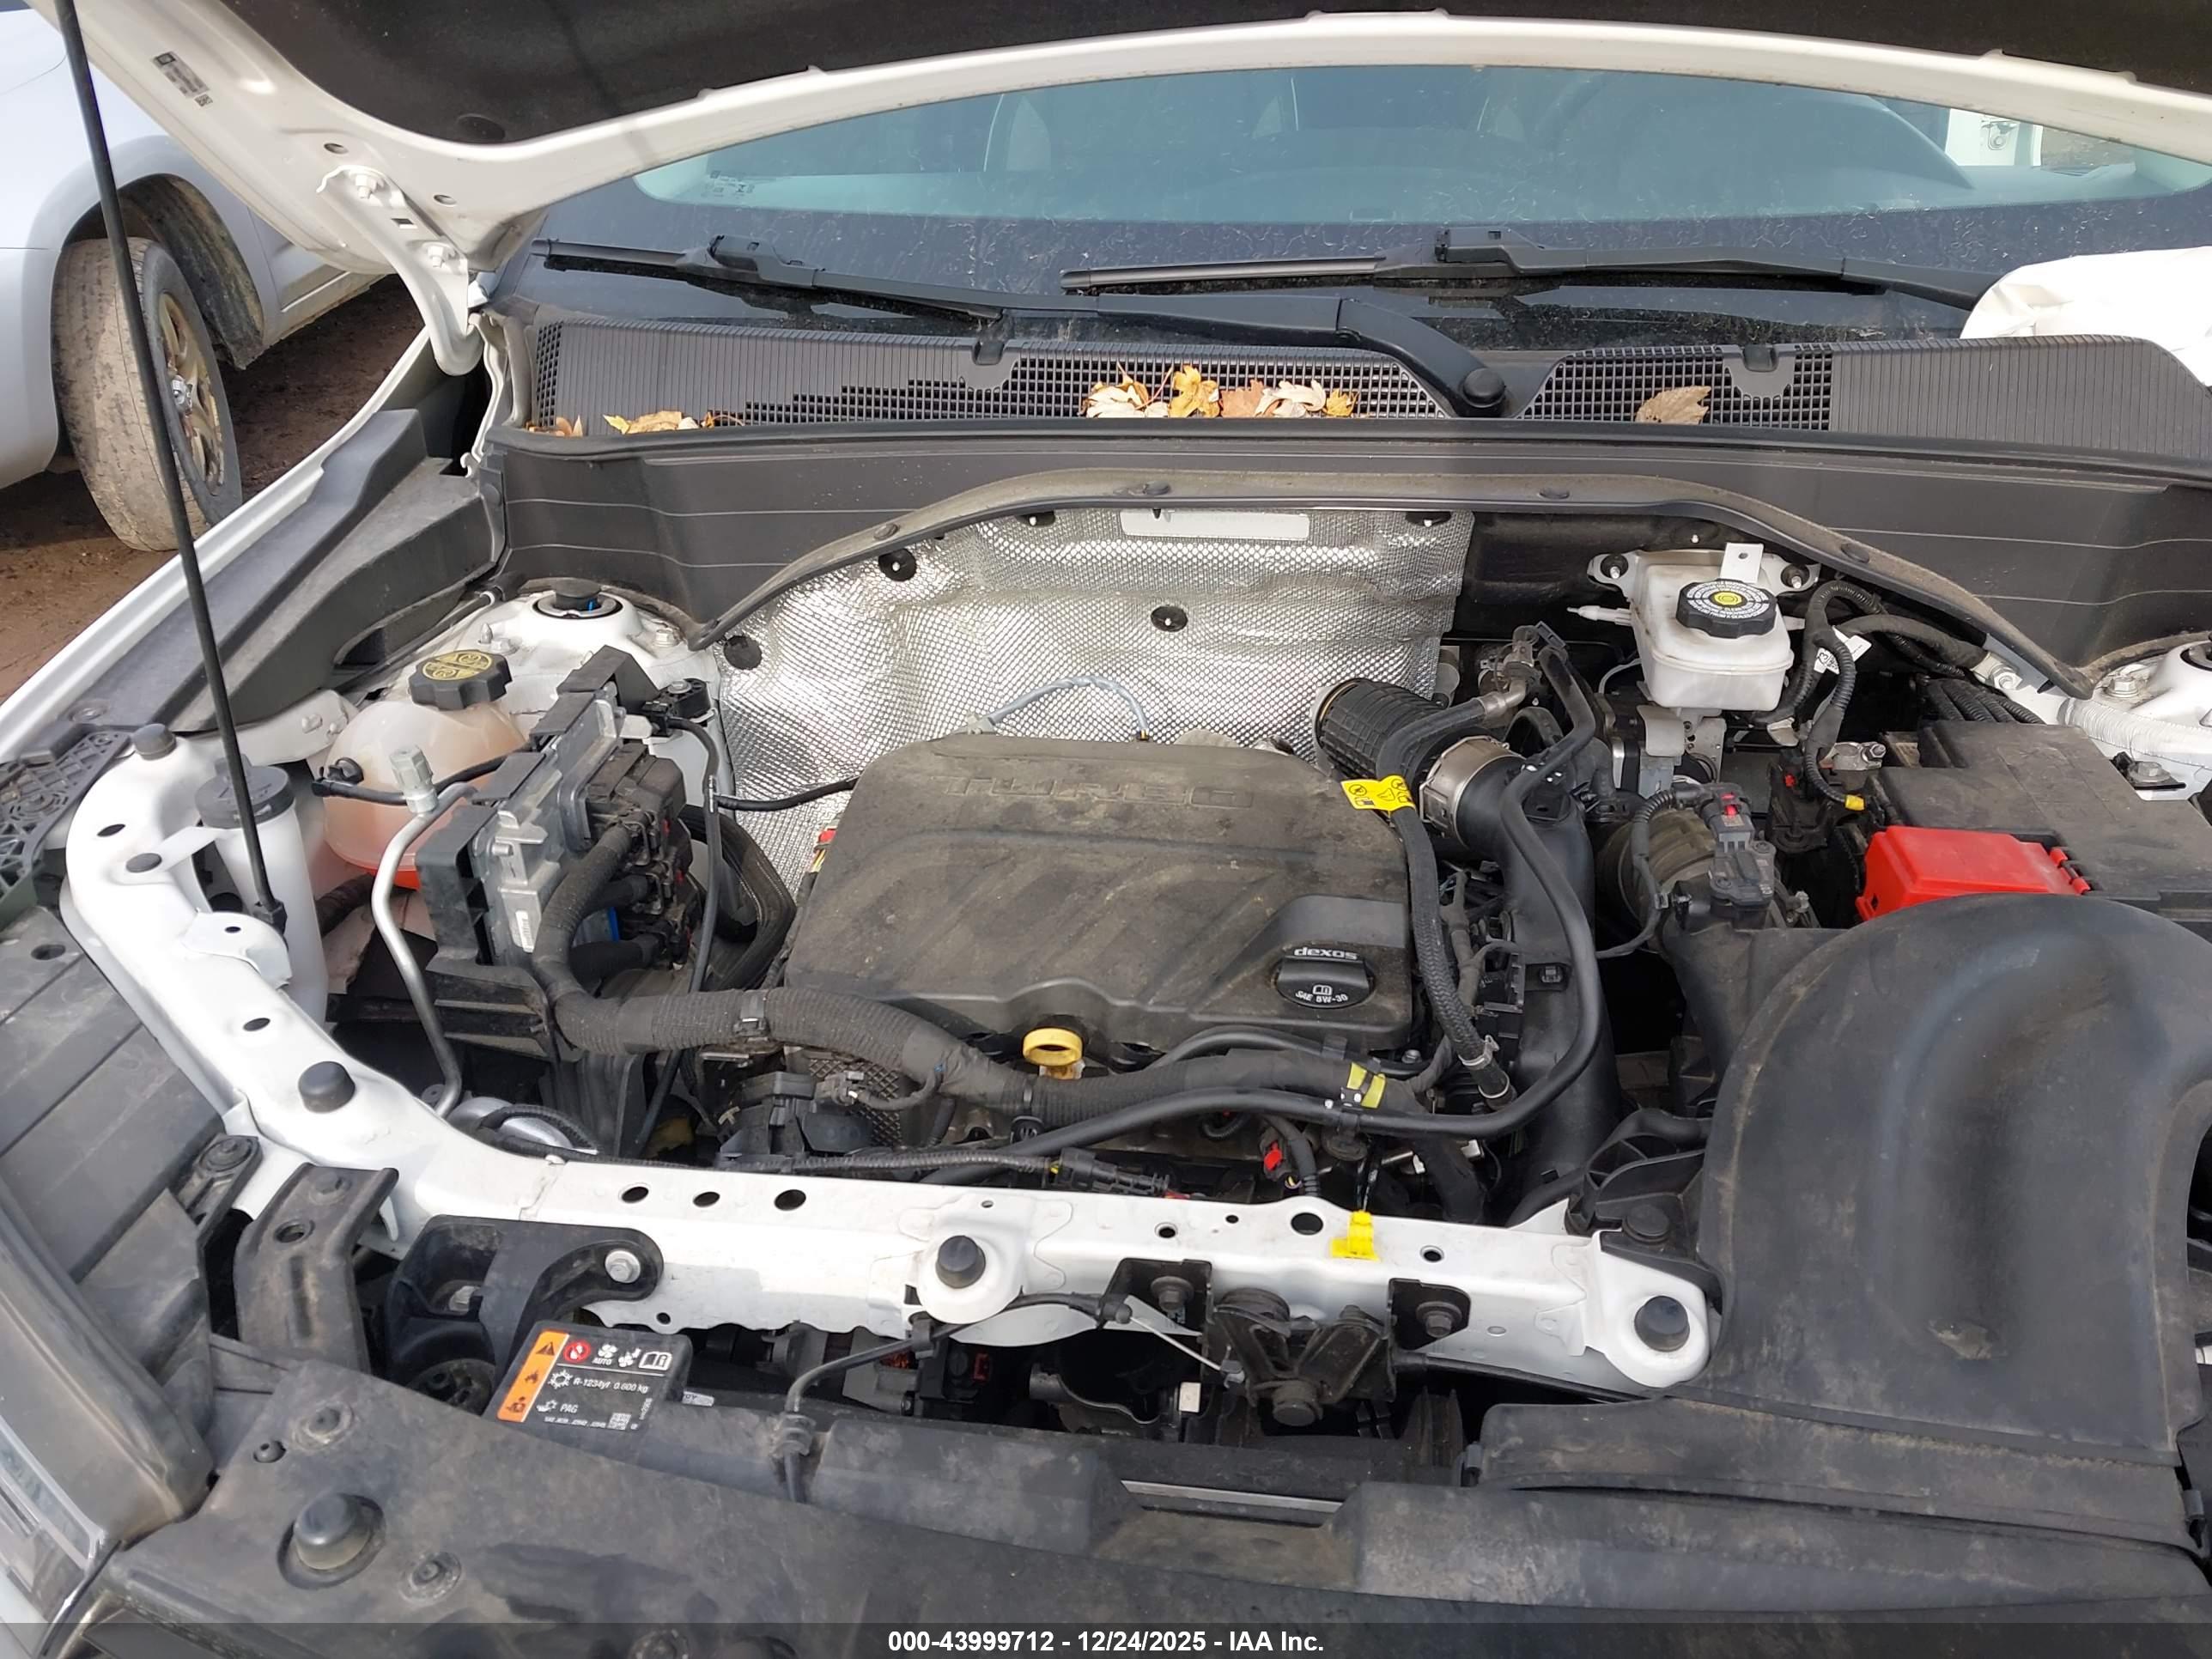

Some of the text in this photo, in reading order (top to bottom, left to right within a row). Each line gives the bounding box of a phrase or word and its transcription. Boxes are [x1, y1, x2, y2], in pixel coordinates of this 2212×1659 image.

[931, 775, 1255, 809] TURBO
[1294, 946, 1358, 960] dexos
[1295, 991, 1348, 1003] SAE 5W-30
[592, 1357, 612, 1365] AUTO
[573, 1377, 611, 1389] R-1234yf
[637, 1383, 649, 1394] kg
[560, 1403, 579, 1413] PAG
